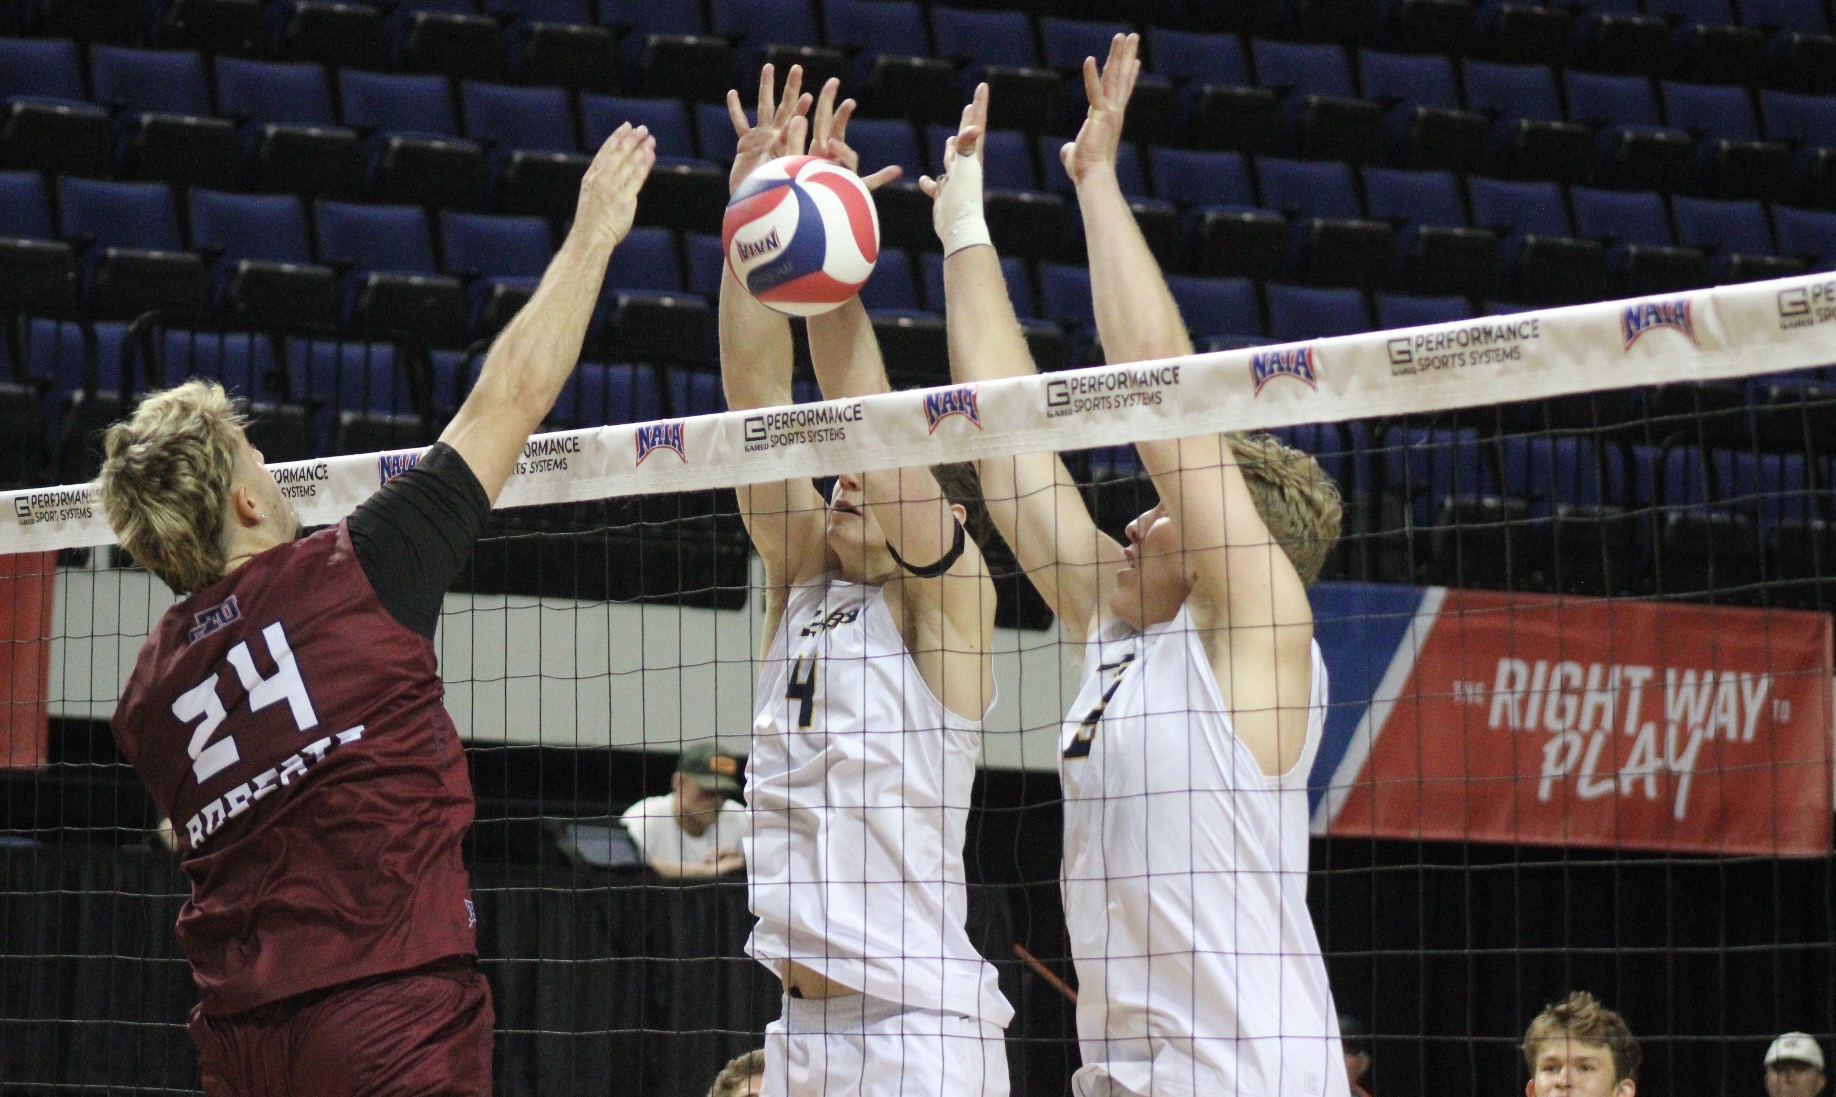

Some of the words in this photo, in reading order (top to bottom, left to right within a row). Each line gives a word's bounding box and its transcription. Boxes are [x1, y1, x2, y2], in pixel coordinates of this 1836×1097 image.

[1414, 319, 1540, 352] PERFORMANCE
[1621, 300, 1694, 343] NAIA
[1252, 346, 1315, 390] NAIA
[1416, 352, 1466, 373] SPORTS
[1469, 346, 1521, 367] SYSTEMS
[1070, 365, 1180, 395] PERFORMANCE
[767, 404, 863, 430] PERFORMANCE
[926, 388, 979, 428] NAIA
[1073, 395, 1112, 413] SPORTS
[1114, 391, 1162, 409] SYSTEMS
[523, 436, 581, 458] ORMANCE
[637, 421, 684, 461] NAIA
[770, 431, 806, 447] SPORTS
[808, 427, 846, 443] SYSTEMS
[270, 464, 329, 484] ORMANCE
[529, 457, 568, 473] SYSTEMS
[32, 489, 92, 509] PERFORMAN
[60, 507, 93, 520] SYSTEMS
[172, 621, 319, 784] 24
[785, 652, 818, 729] 4
[1488, 657, 1654, 736] RIGHT
[1664, 667, 1774, 744] WAY
[1537, 721, 1705, 822] PLAY
